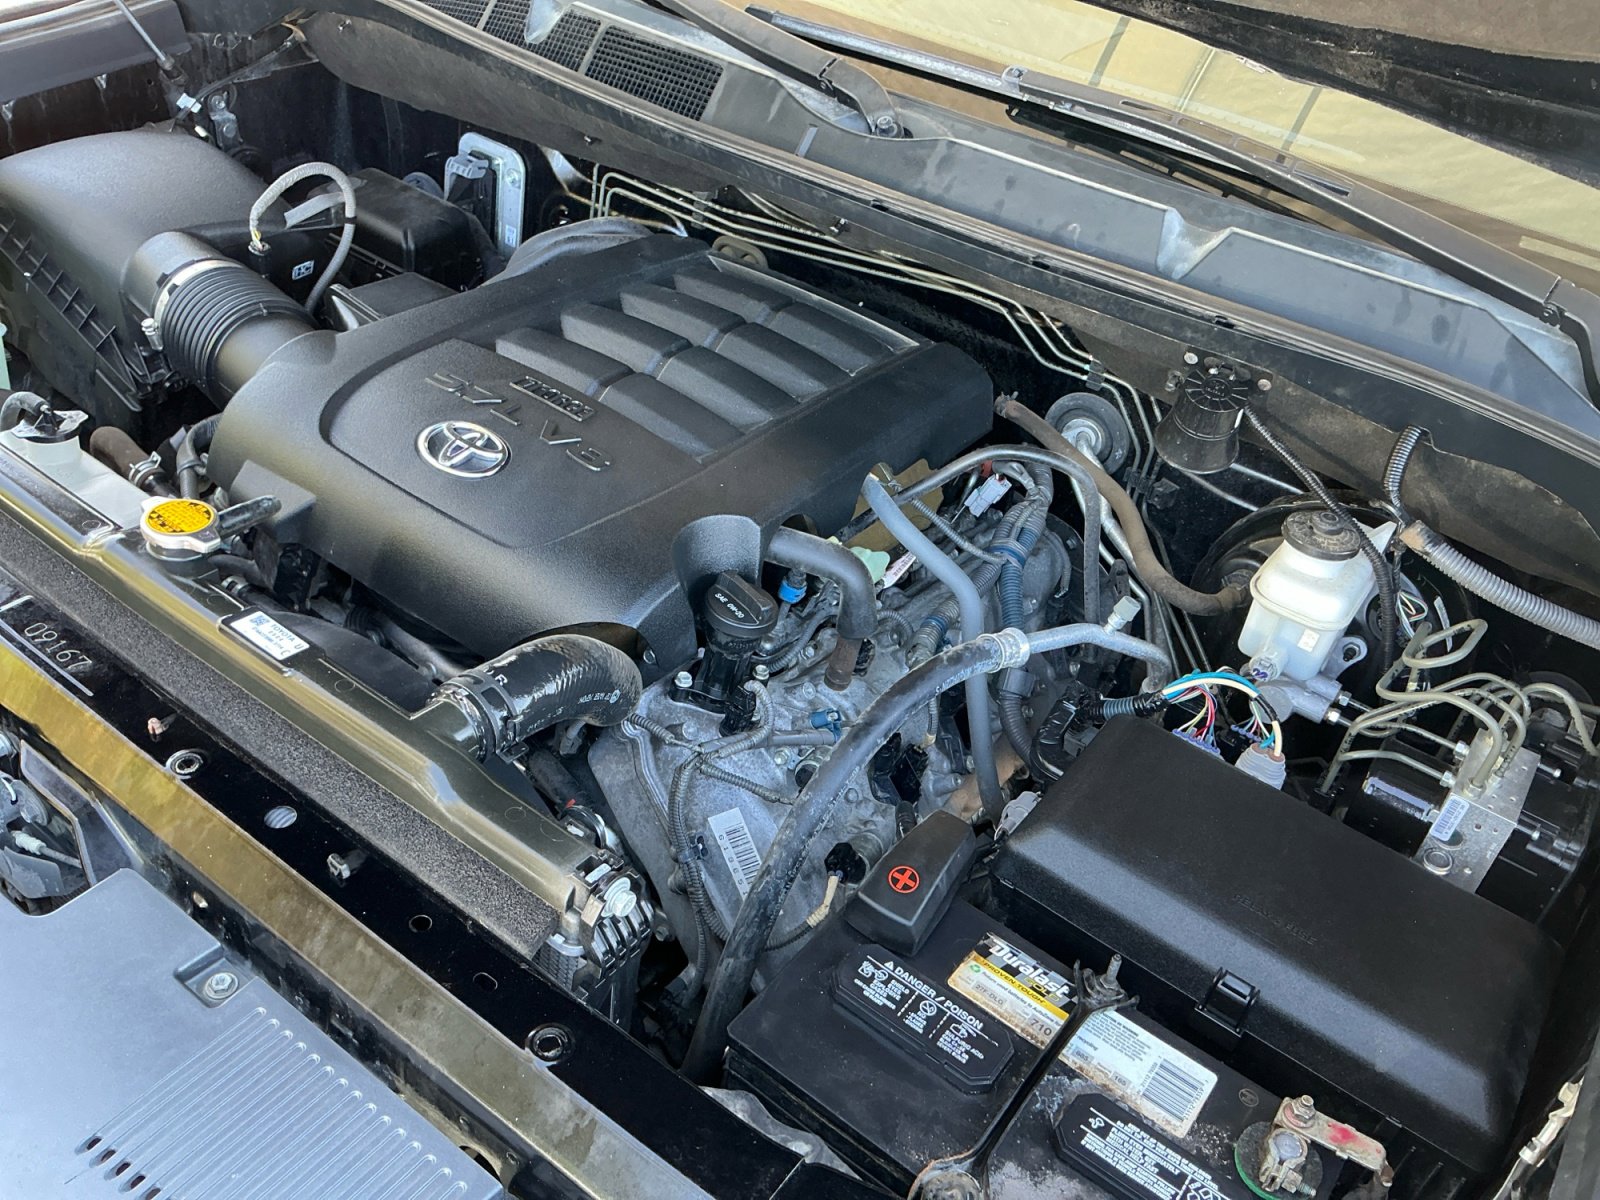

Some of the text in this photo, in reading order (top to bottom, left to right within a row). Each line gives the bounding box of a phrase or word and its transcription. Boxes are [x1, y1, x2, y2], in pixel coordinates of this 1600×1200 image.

[714, 592, 729, 604] SAE
[271, 623, 297, 643] TOYOTA
[24, 622, 93, 670] 09167
[988, 943, 1070, 998] Duralast
[872, 979, 902, 1001] EXPLOSIVE
[887, 983, 903, 995] EYES
[890, 979, 911, 995] SHIELD
[983, 962, 1016, 984] PROVEN
[1016, 984, 1045, 1004] TOUGH
[1024, 976, 1060, 1002] GOLD
[894, 966, 938, 999] DANGER
[943, 999, 984, 1031] POISON
[1030, 1018, 1054, 1037] 710
[944, 1029, 985, 1060] SULFURIC ACID
[1077, 1035, 1099, 1051] recycling
[1143, 1161, 1159, 1175] FAST
